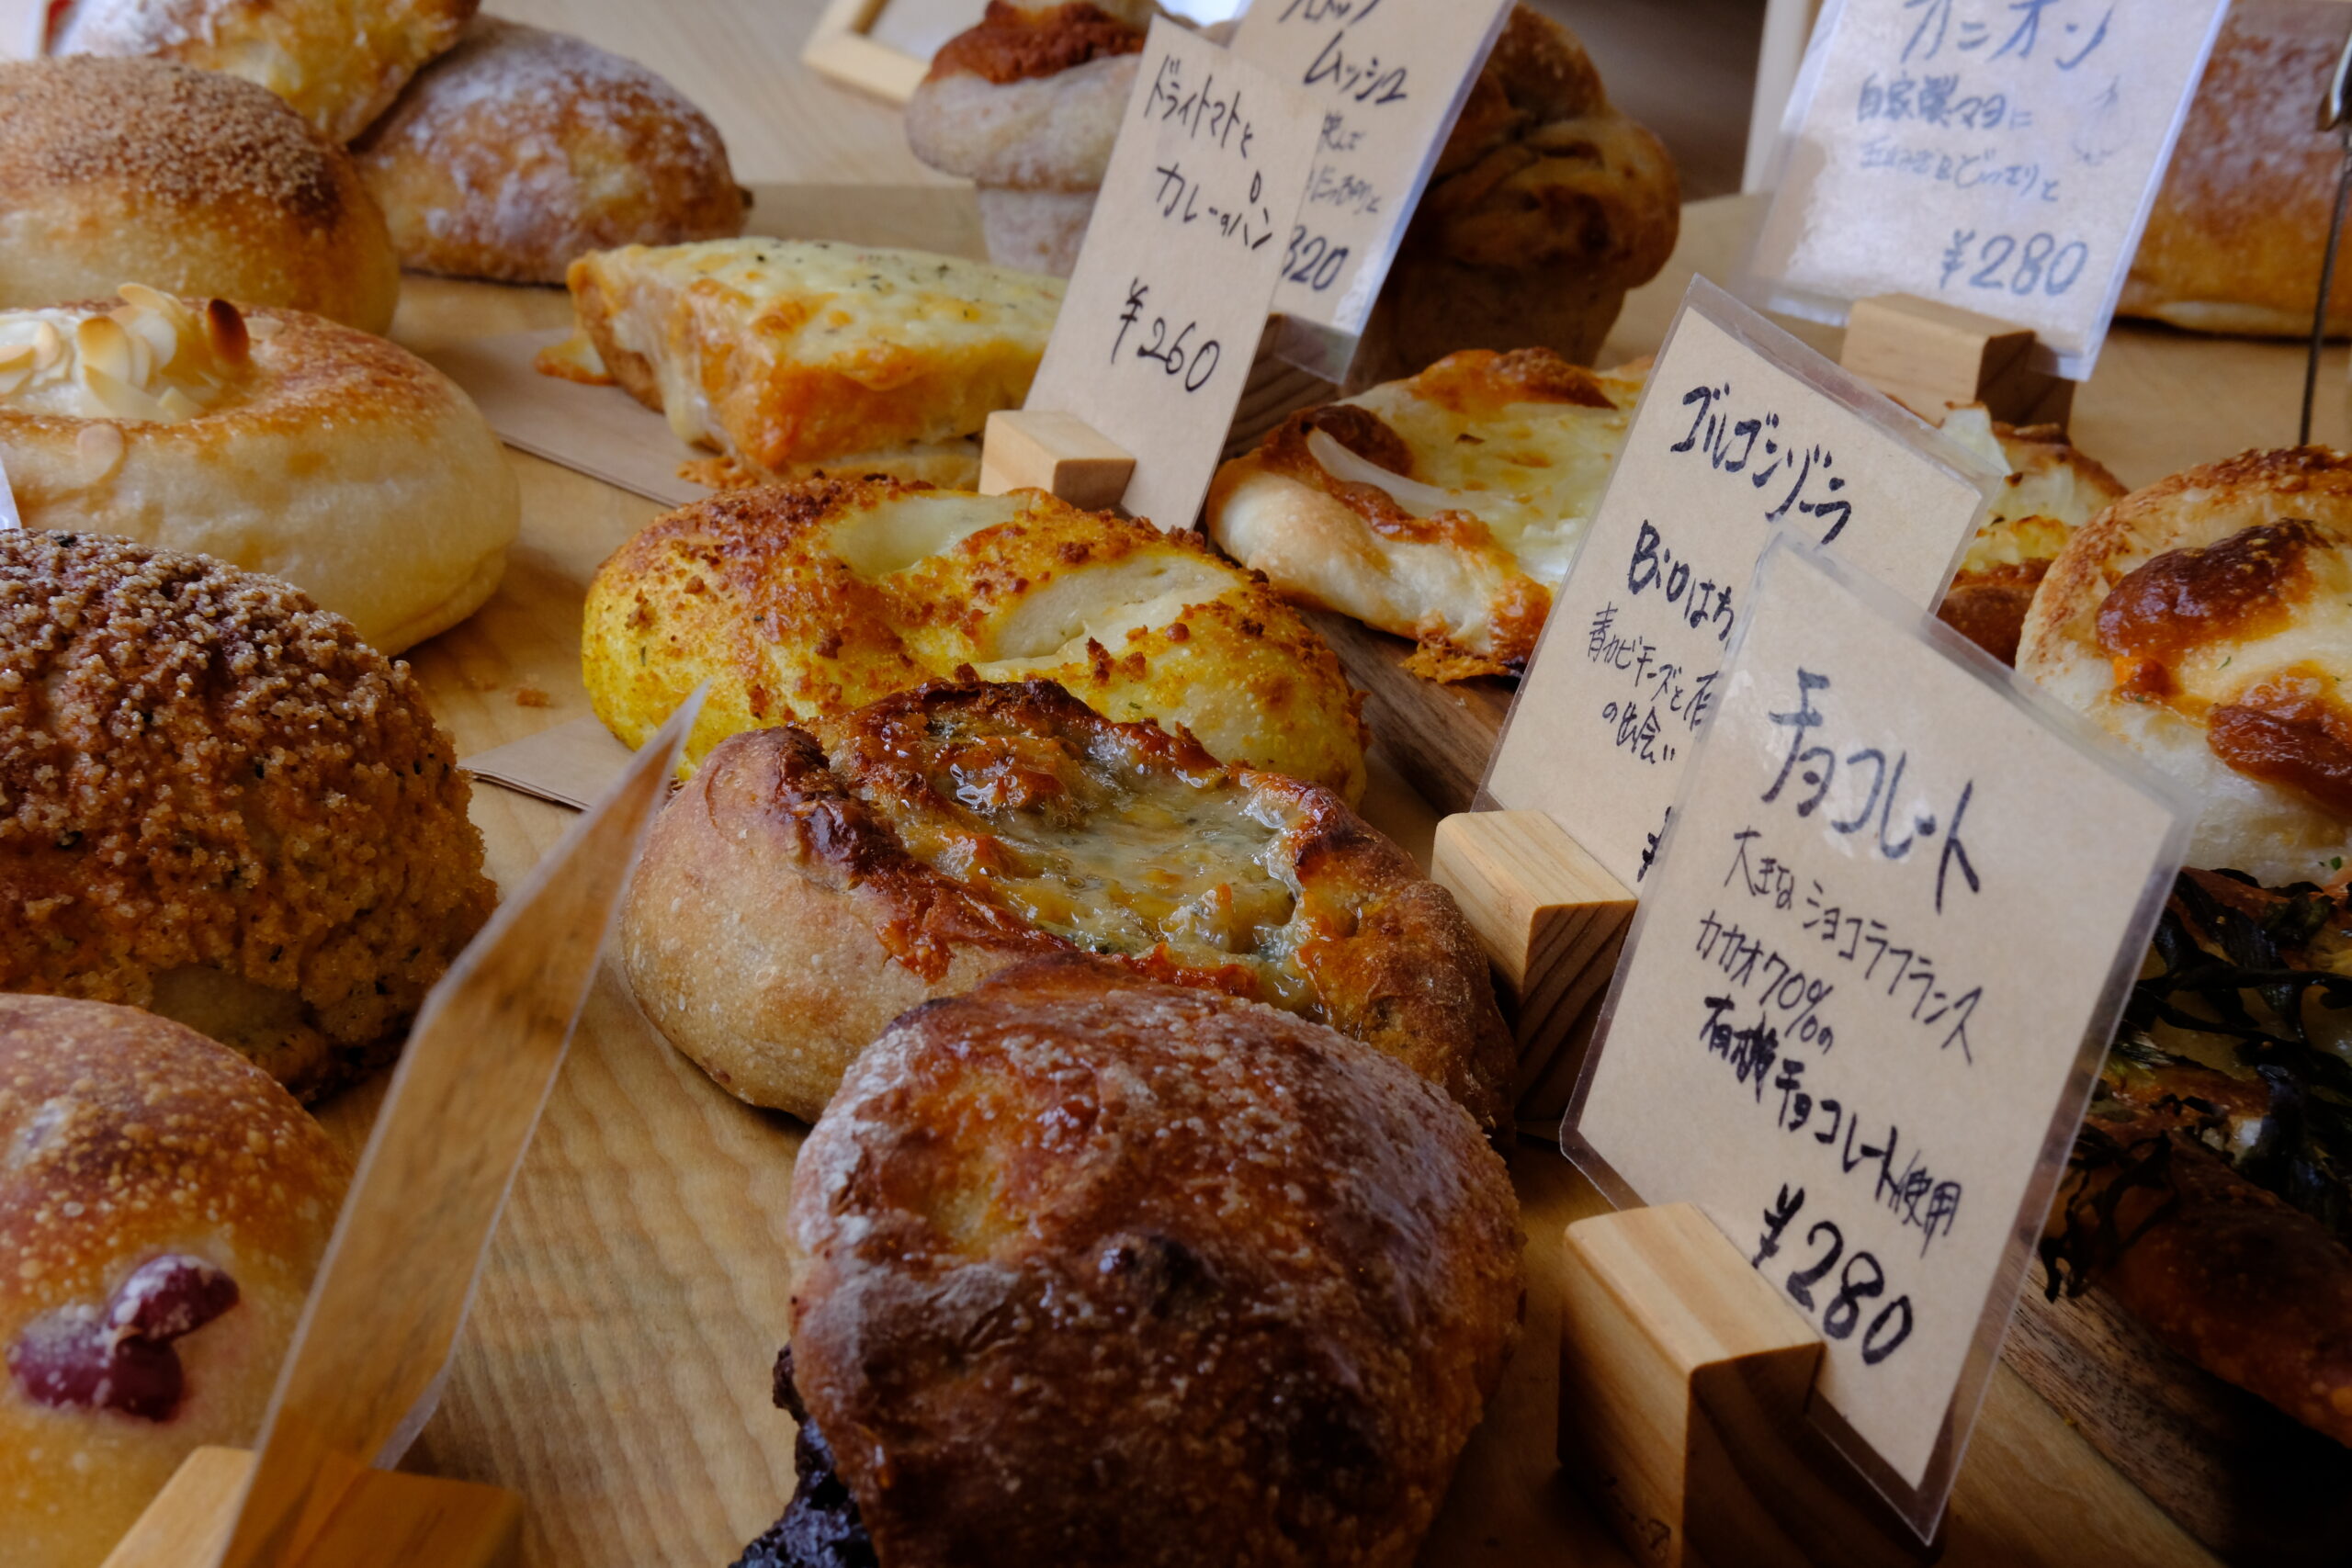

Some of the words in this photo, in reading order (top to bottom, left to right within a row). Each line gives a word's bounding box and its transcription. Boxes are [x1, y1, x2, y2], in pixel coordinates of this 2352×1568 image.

[1144, 54, 1254, 160] ドライトマトと
[1939, 230, 2088, 297] ¥280
[1111, 277, 1220, 392] ¥260
[1627, 520, 1735, 650] Bioはち
[1760, 666, 1980, 916] チョコレート
[1751, 1182, 1914, 1366] ¥280
